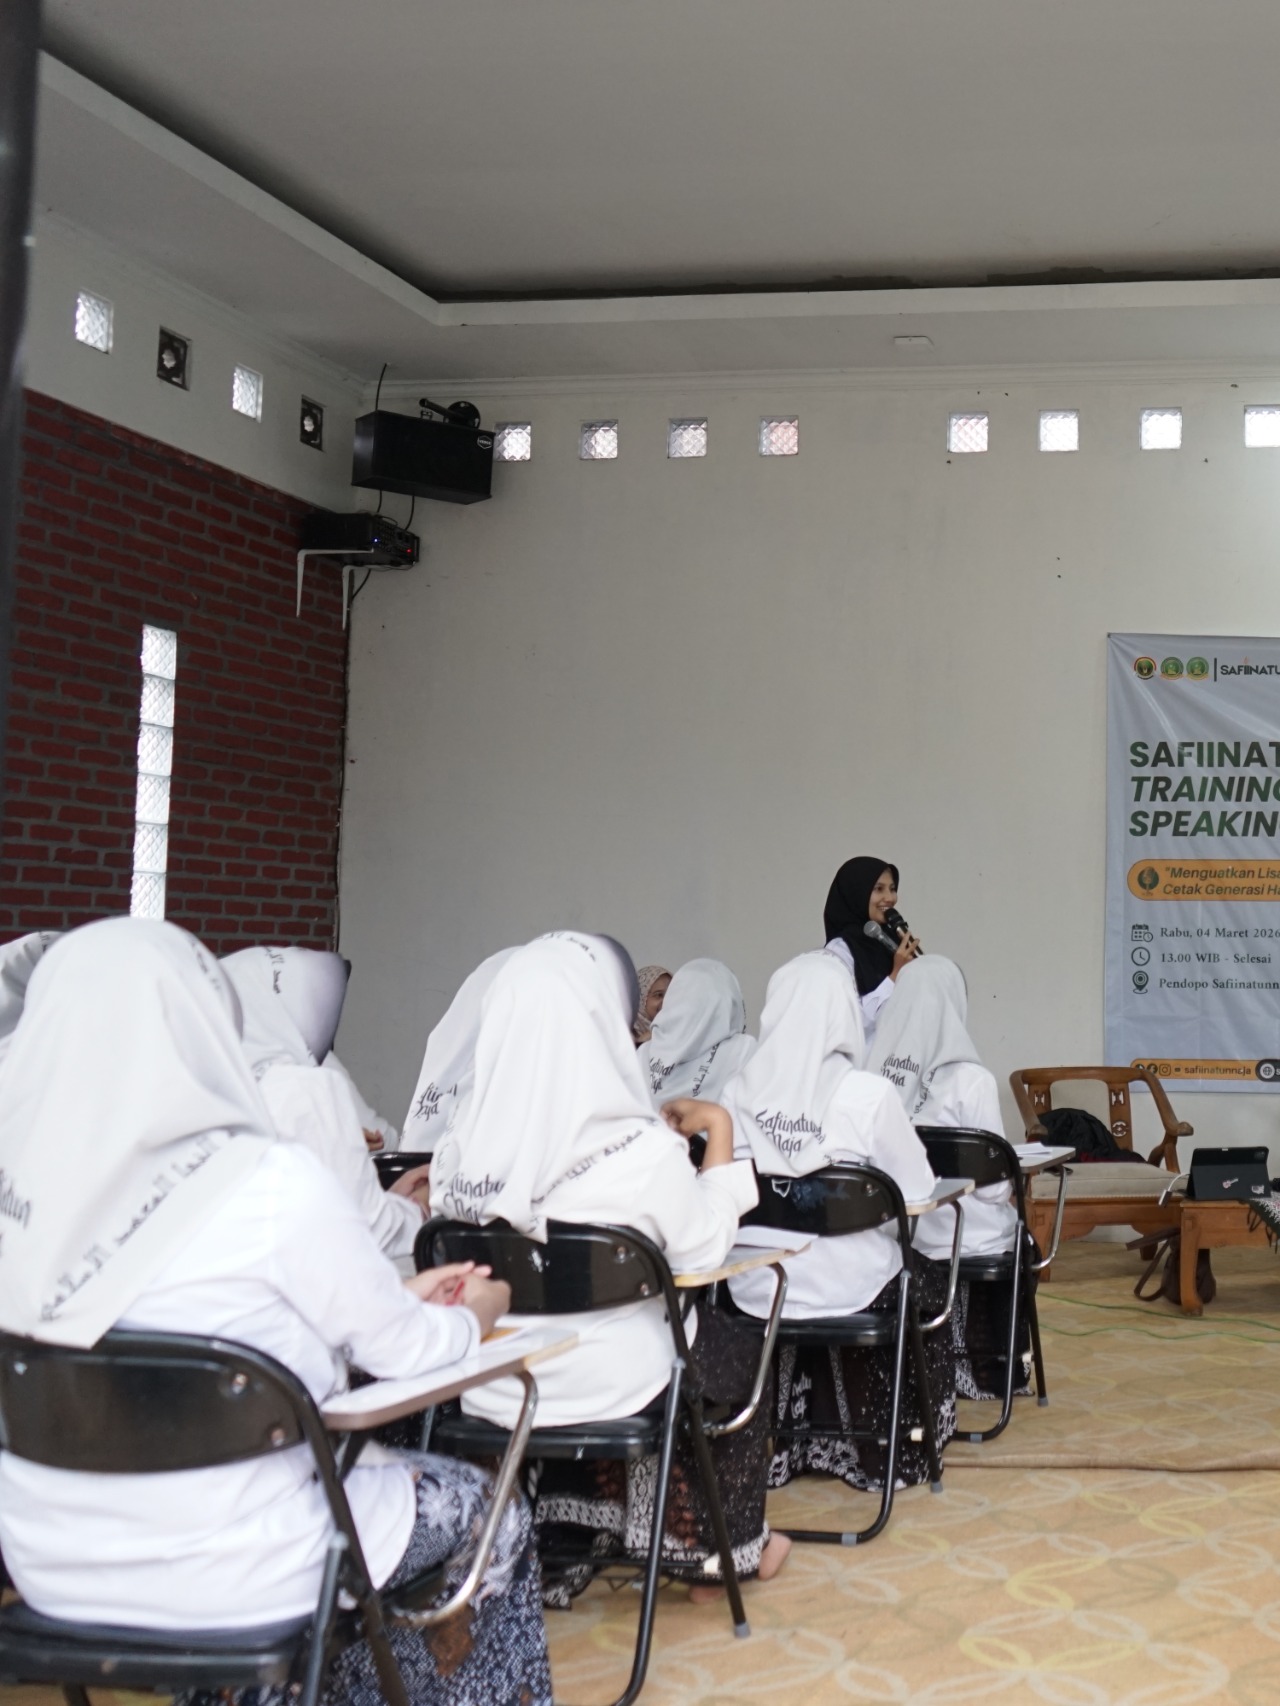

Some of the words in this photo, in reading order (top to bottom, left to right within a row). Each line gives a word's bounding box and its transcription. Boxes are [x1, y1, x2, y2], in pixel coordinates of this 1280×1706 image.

[1163, 883, 1203, 896] Cetak
[1205, 883, 1265, 896] Generasi
[1160, 927, 1193, 939] Rabu,
[1196, 928, 1210, 938] 04
[1215, 927, 1248, 938] Maret
[1253, 928, 1280, 938] 2026
[1160, 953, 1191, 963] 13.00
[1196, 953, 1220, 963] WIB
[1233, 953, 1272, 964] Selesai
[1159, 978, 1209, 991] Pendopo
